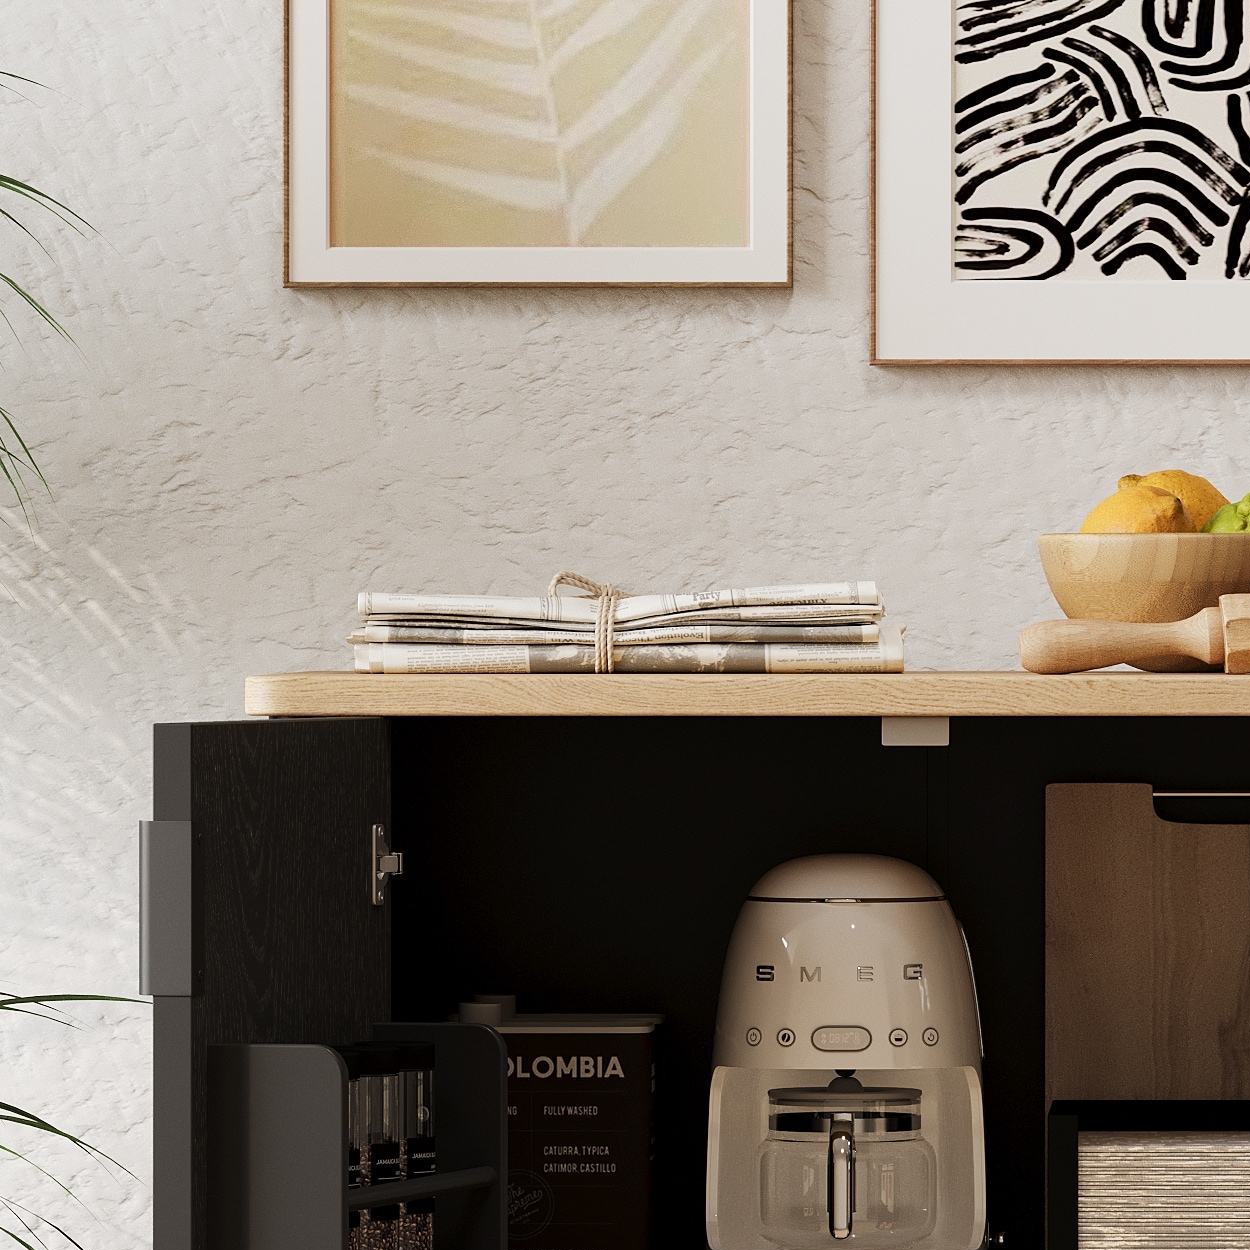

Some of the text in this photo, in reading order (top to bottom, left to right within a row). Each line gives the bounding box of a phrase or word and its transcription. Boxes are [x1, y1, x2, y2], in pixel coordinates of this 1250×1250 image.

[693, 591, 721, 602] Party
[755, 964, 923, 982] SMEG
[508, 1055, 626, 1079] LOMBIA
[543, 1105, 599, 1116] FULLY WASHED
